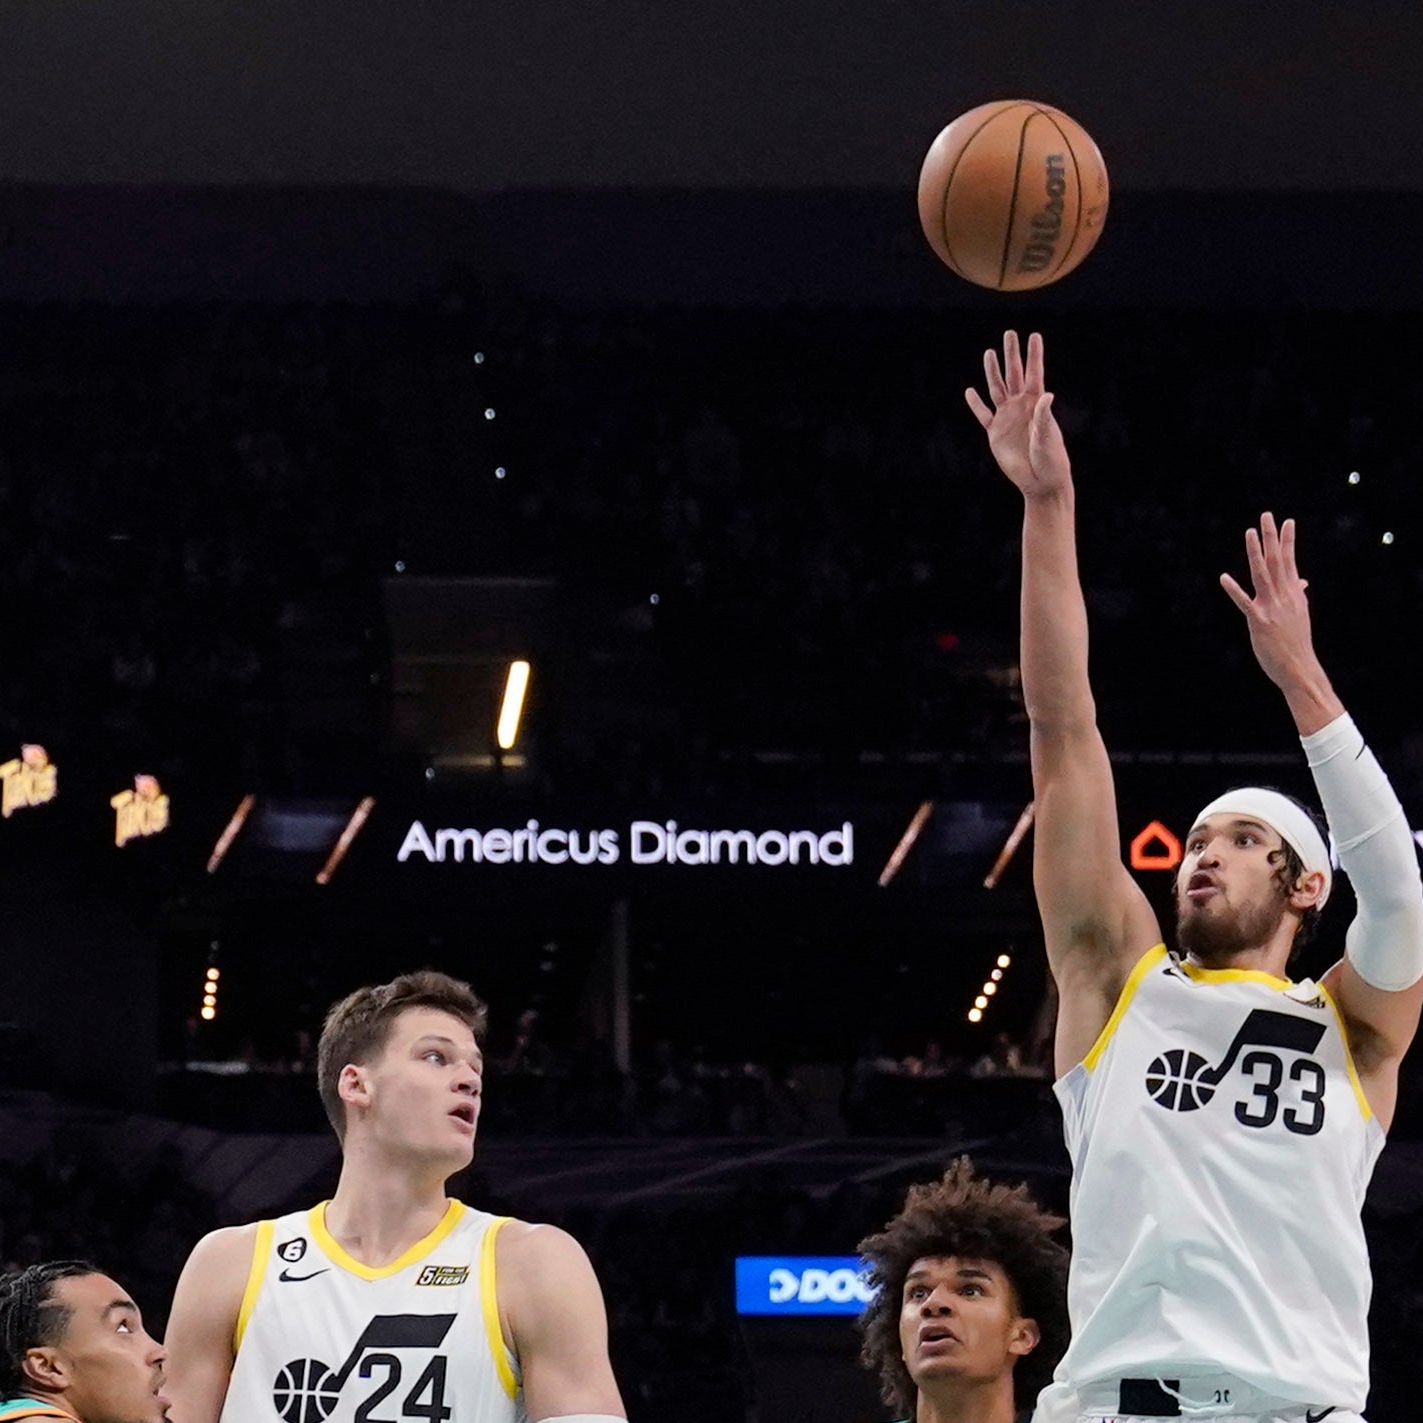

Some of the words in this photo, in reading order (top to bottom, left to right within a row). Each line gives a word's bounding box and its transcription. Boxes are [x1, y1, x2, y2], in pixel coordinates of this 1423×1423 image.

[1019, 153, 1066, 273] Wilson
[397, 819, 619, 864] Americus
[629, 820, 855, 867] Diamond
[1233, 1050, 1327, 1137] 33
